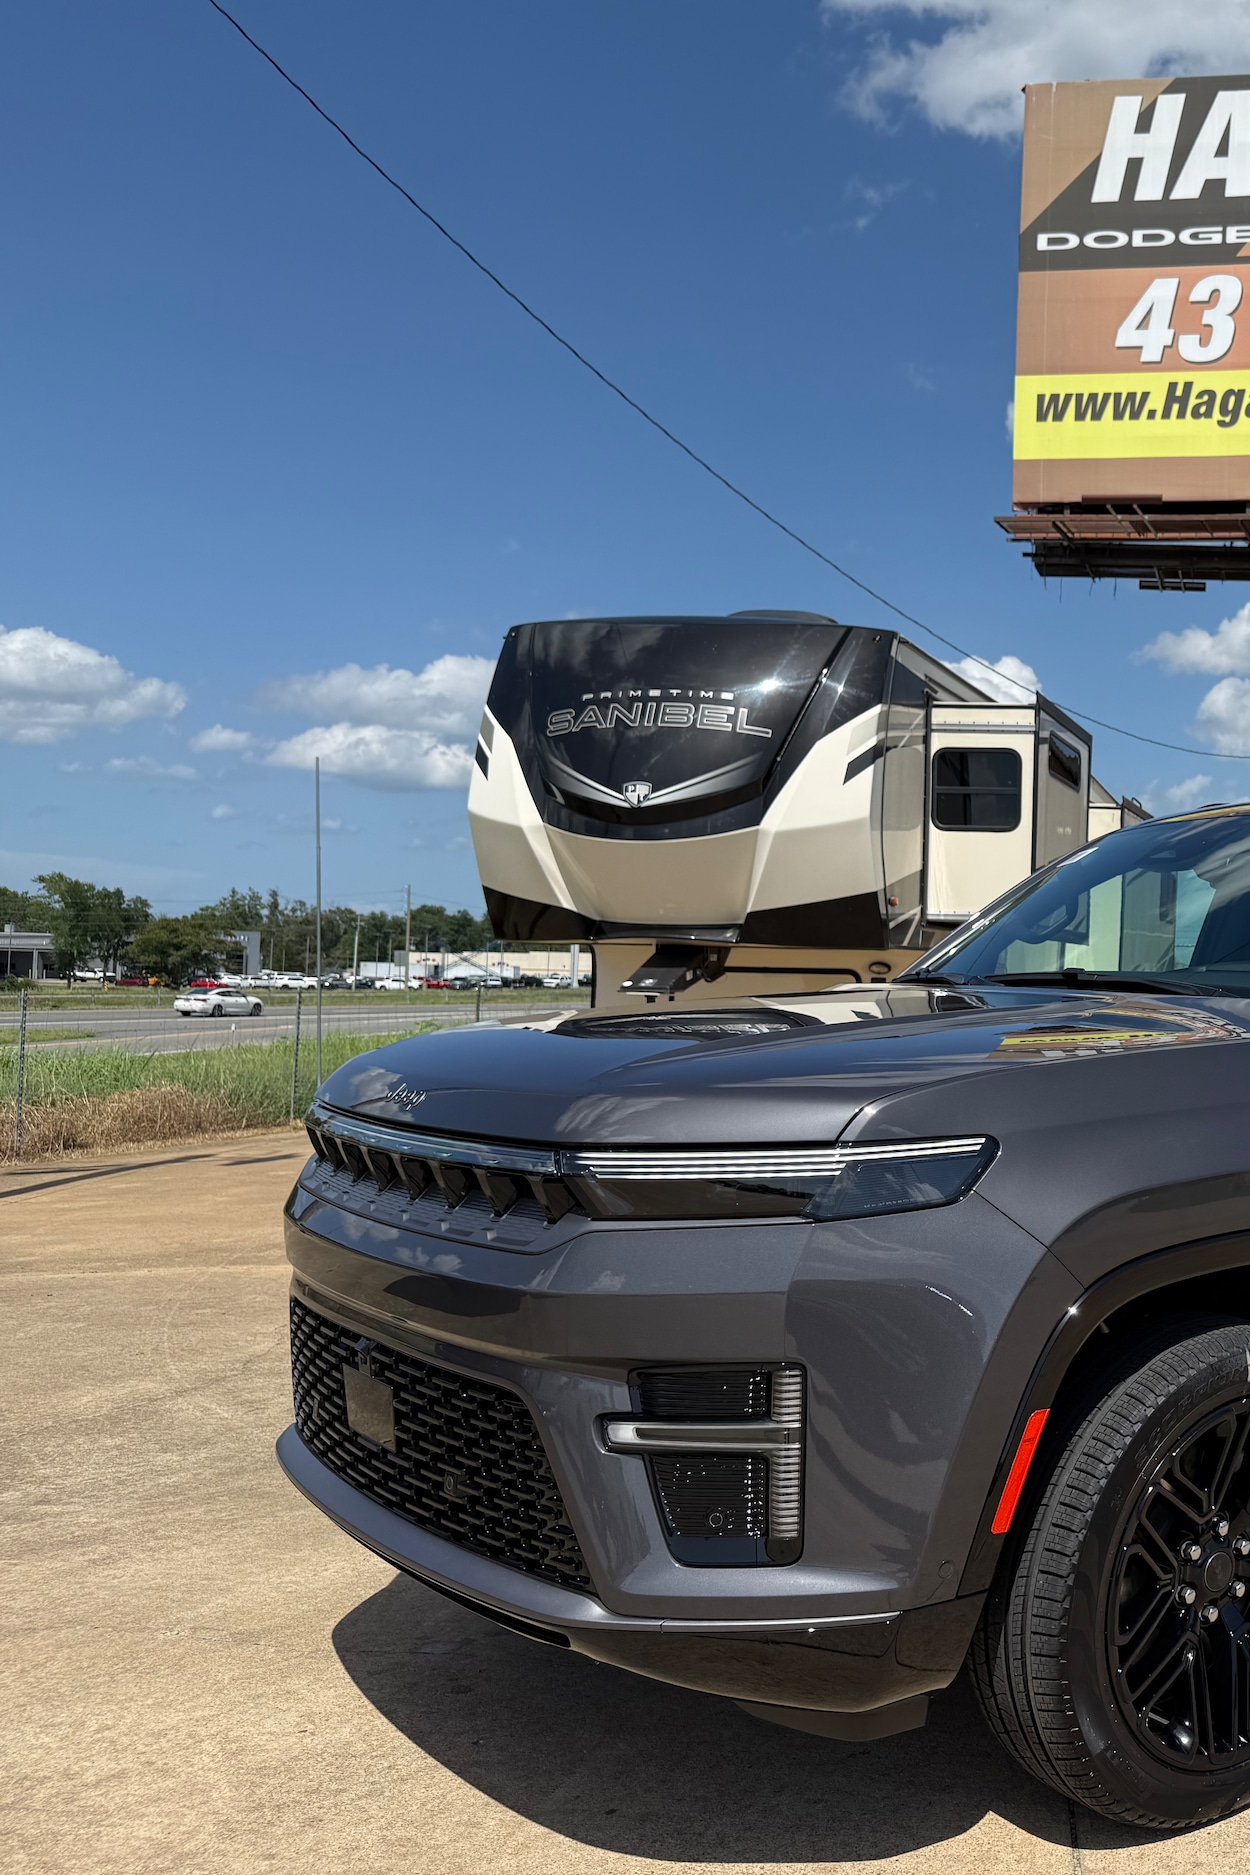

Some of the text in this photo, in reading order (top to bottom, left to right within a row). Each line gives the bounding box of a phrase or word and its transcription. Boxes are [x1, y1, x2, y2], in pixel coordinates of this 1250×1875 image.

[1114, 274, 1244, 364] 43
[546, 702, 773, 738] SANIBEL
[385, 1082, 427, 1112] Jeep
